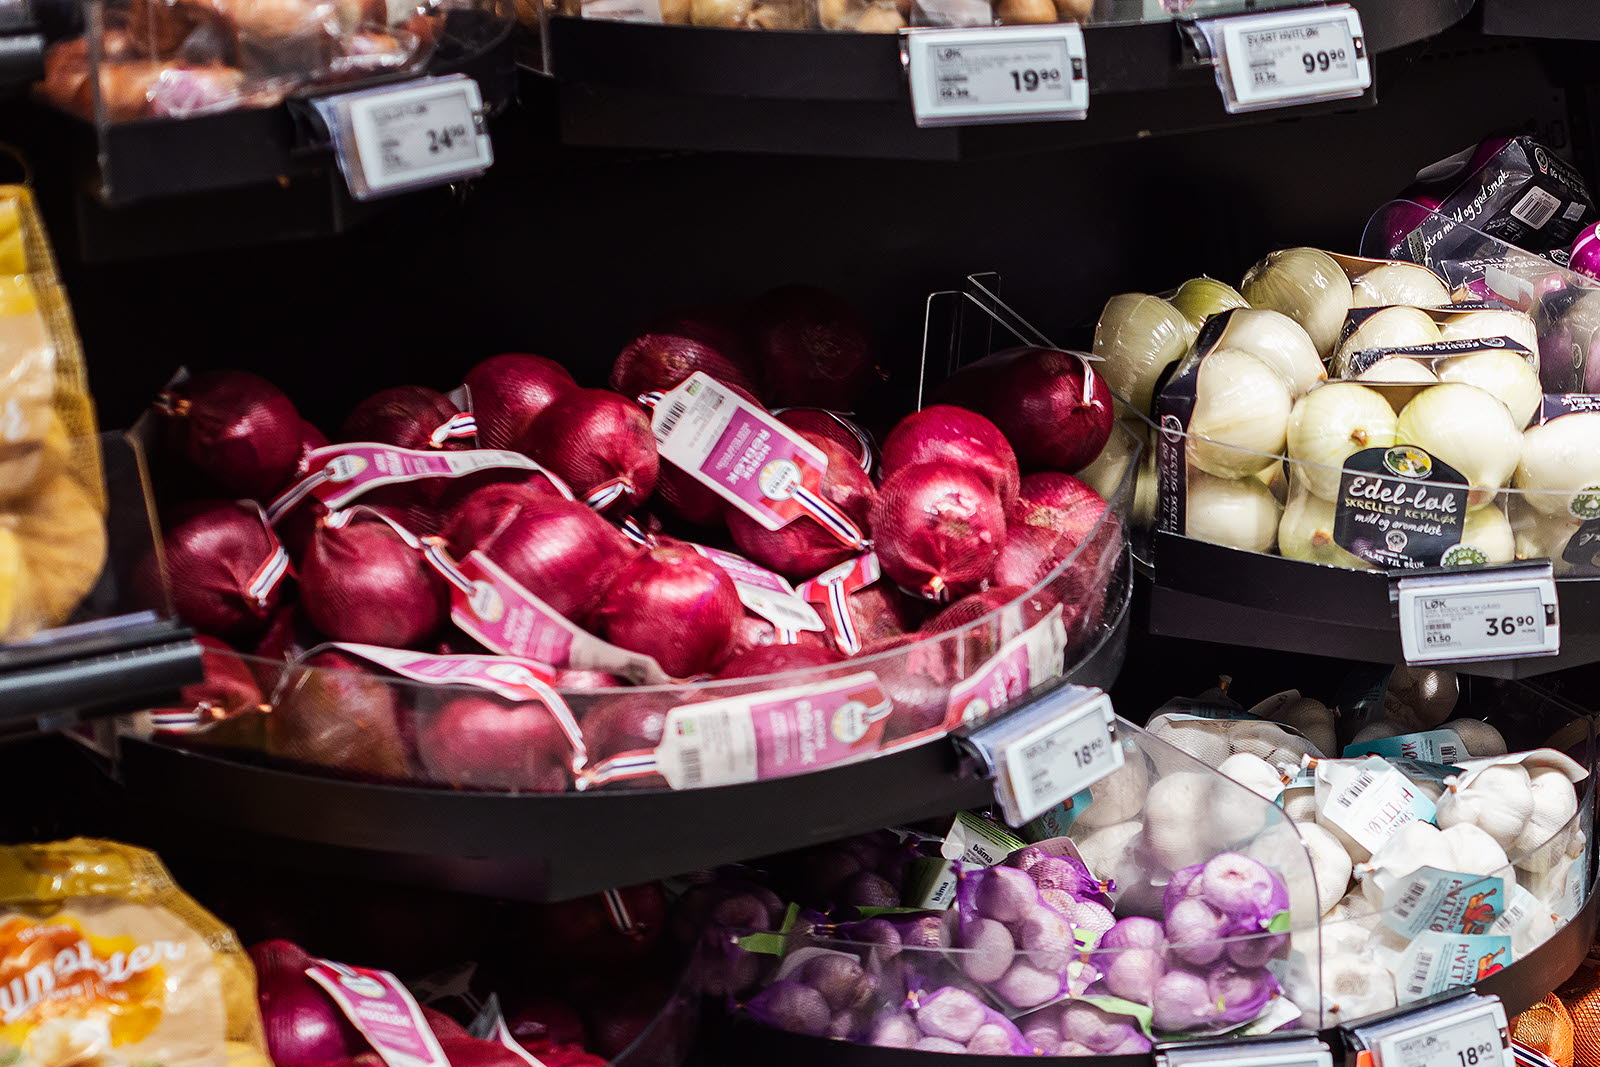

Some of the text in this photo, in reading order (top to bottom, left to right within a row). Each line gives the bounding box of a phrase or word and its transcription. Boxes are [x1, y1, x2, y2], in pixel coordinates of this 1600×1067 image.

[1349, 476, 1458, 513] Edel-løk
[1345, 498, 1457, 525] SKRELLET KEPALØK
[1379, 518, 1391, 531] og
[1424, 600, 1447, 610] LØK
[1485, 615, 1535, 636] 3690
[1457, 1042, 1493, 1067] 1890
